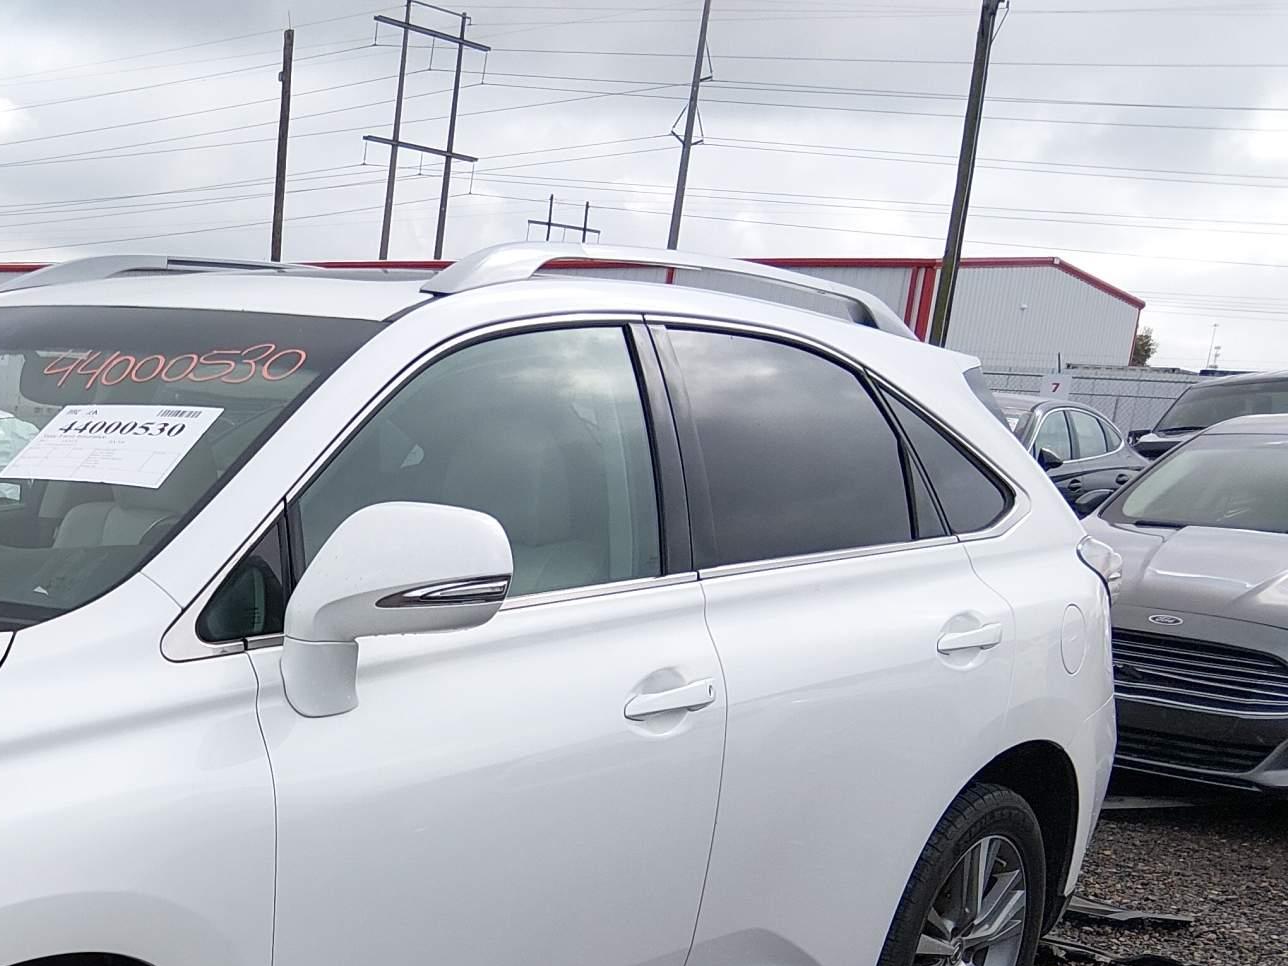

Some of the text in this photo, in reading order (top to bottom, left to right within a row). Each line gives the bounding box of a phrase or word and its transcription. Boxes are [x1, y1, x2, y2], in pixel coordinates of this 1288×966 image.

[43, 343, 307, 389] 44000530
[1051, 382, 1061, 393] 7
[59, 420, 186, 438] 44000530
